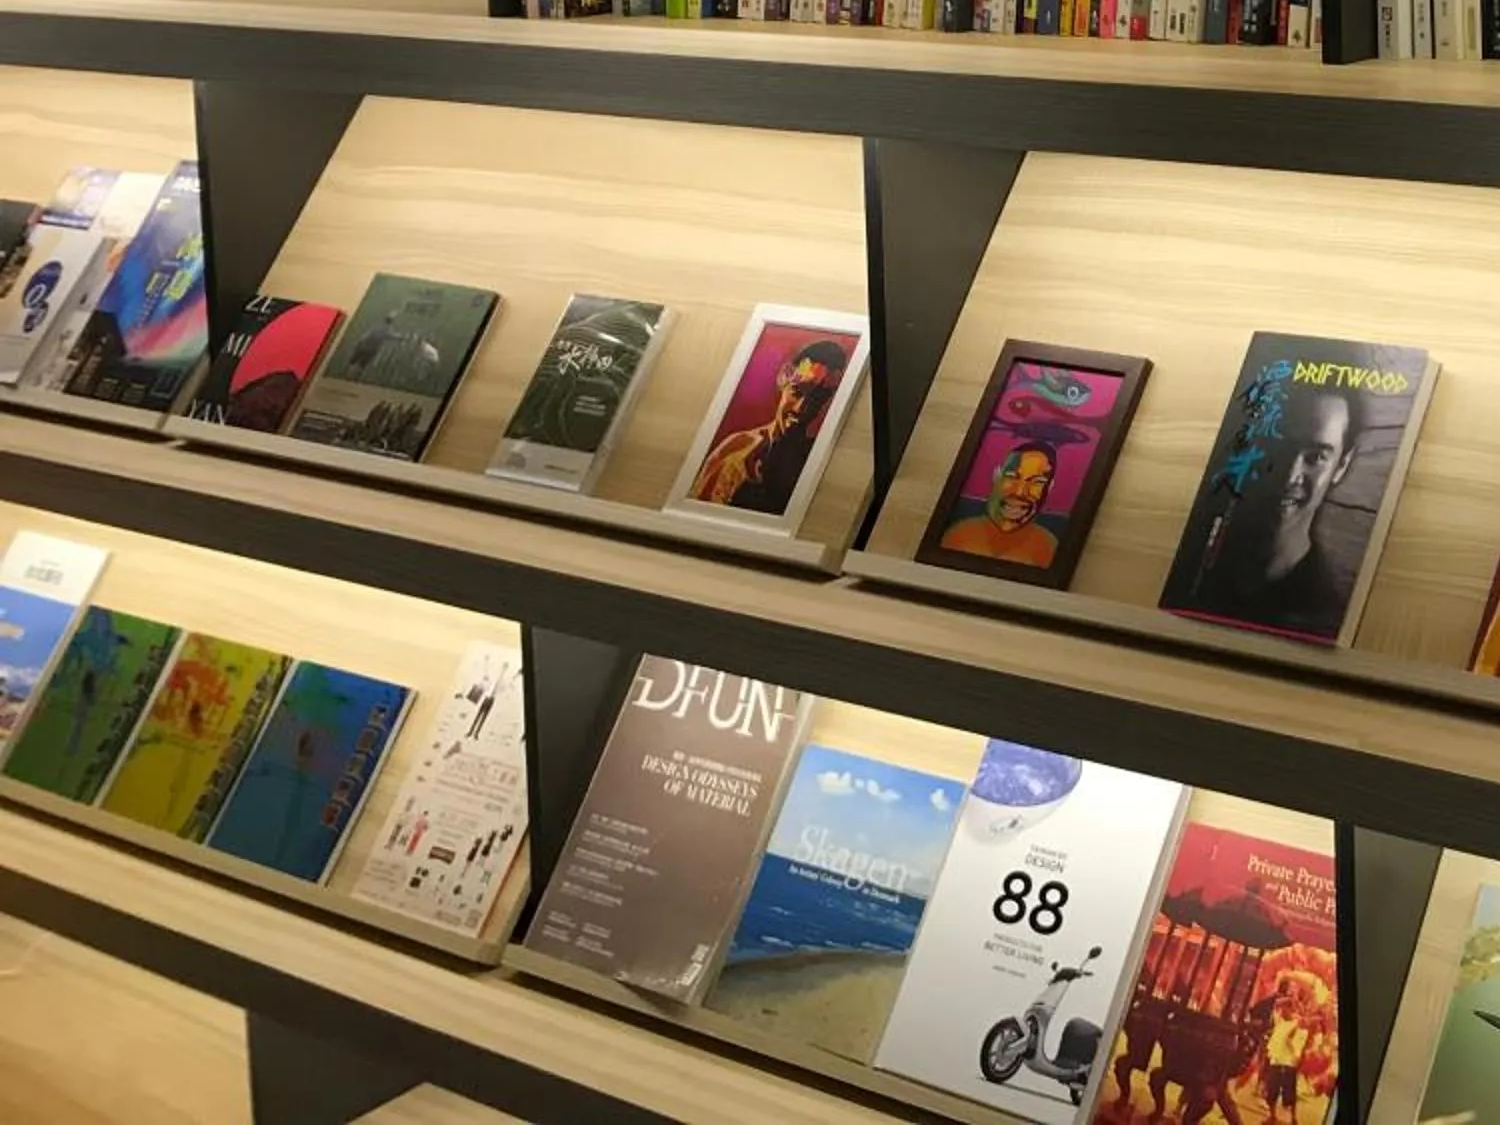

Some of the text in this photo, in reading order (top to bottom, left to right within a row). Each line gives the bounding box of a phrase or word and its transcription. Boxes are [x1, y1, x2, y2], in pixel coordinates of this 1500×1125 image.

[1292, 359, 1409, 389] DRIFTWOOD
[631, 660, 797, 743] DFUN
[686, 786, 753, 818] MATERIAL
[797, 824, 908, 891] Skagen
[1024, 852, 1066, 875] DESIGN
[1247, 853, 1294, 880] Private
[992, 870, 1070, 936] 88
[1278, 882, 1323, 911] Public
[984, 938, 1045, 967] BETTER LIVING
